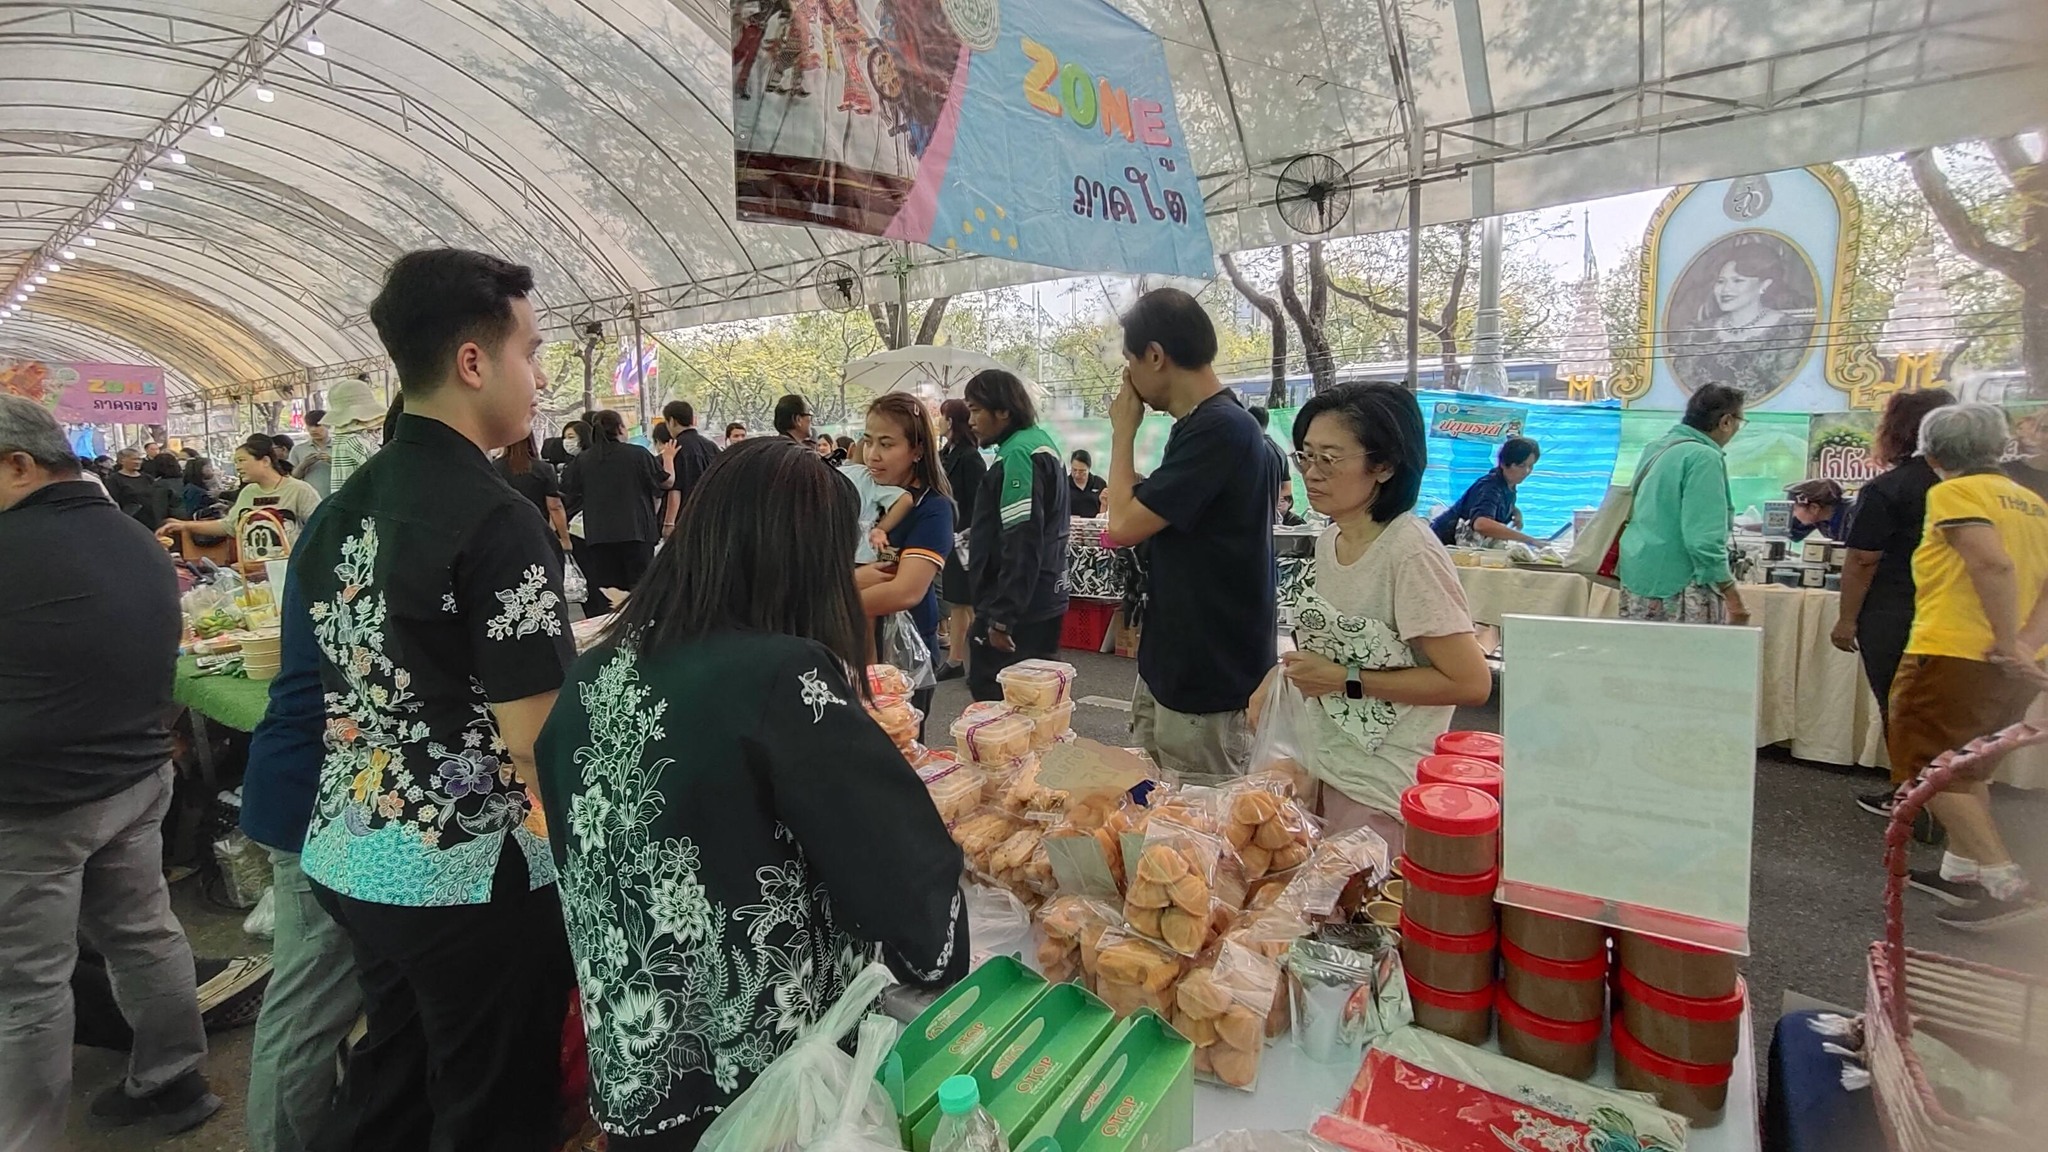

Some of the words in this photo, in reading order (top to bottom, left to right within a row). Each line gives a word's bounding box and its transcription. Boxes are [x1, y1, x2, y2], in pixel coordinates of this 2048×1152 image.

[1020, 36, 1172, 147] ZONE
[1073, 157, 1188, 224] ภาคใต้
[87, 379, 158, 395] ZONE
[93, 399, 158, 411] ภาคกลาง
[949, 1021, 985, 1054] OTOP
[1016, 1056, 1053, 1093] OTOP
[1101, 1095, 1137, 1137] OTOP
